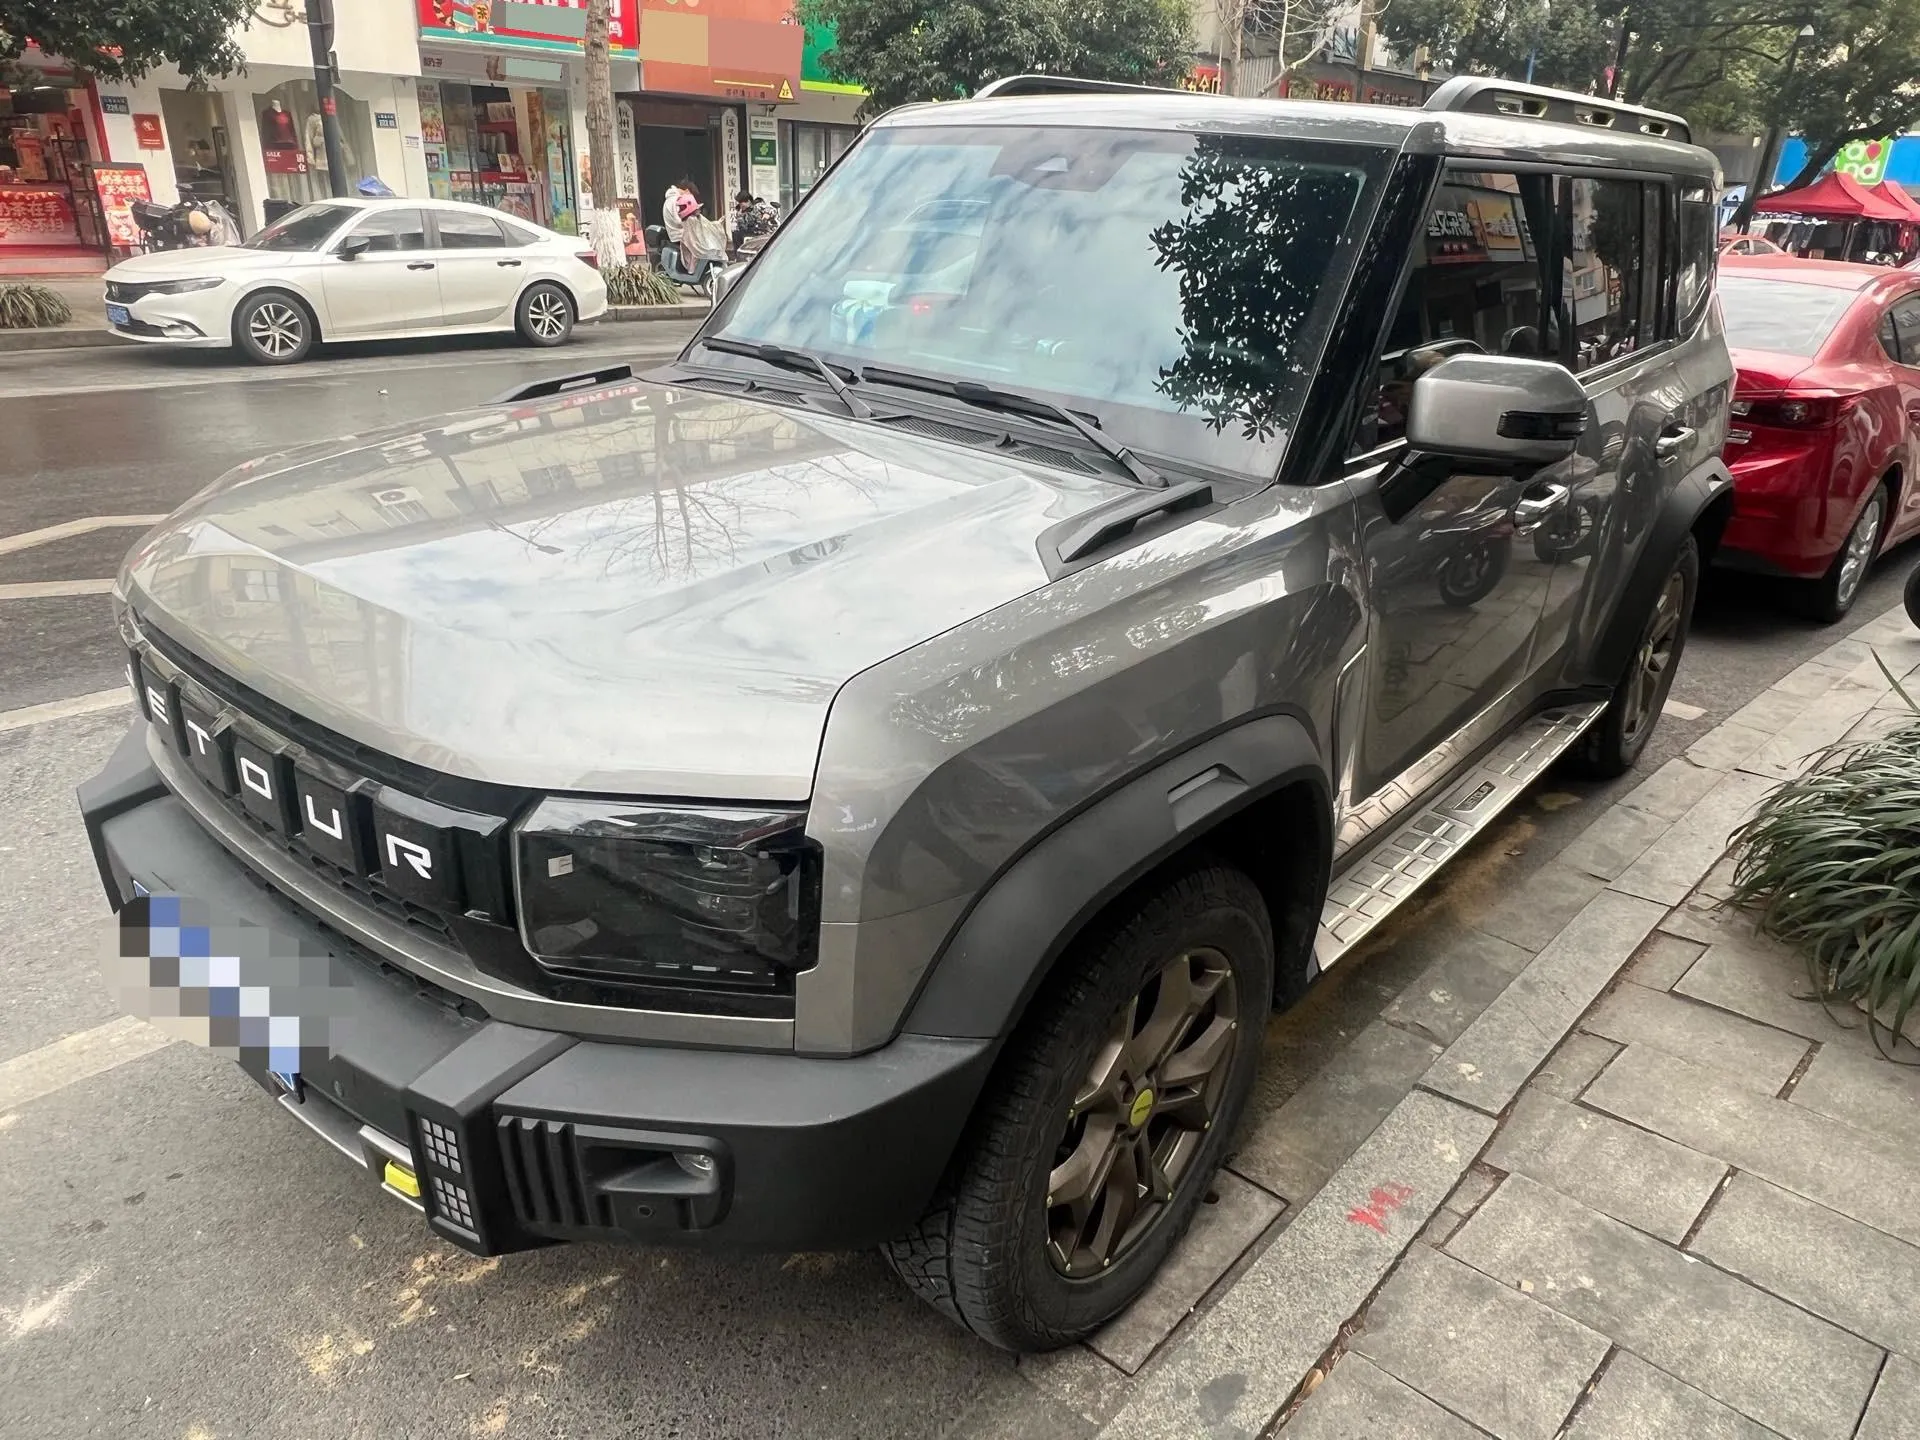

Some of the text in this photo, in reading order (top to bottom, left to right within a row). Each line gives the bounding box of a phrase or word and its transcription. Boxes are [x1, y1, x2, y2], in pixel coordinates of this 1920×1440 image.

[618, 106, 634, 199] 杭州第一汽车运输
